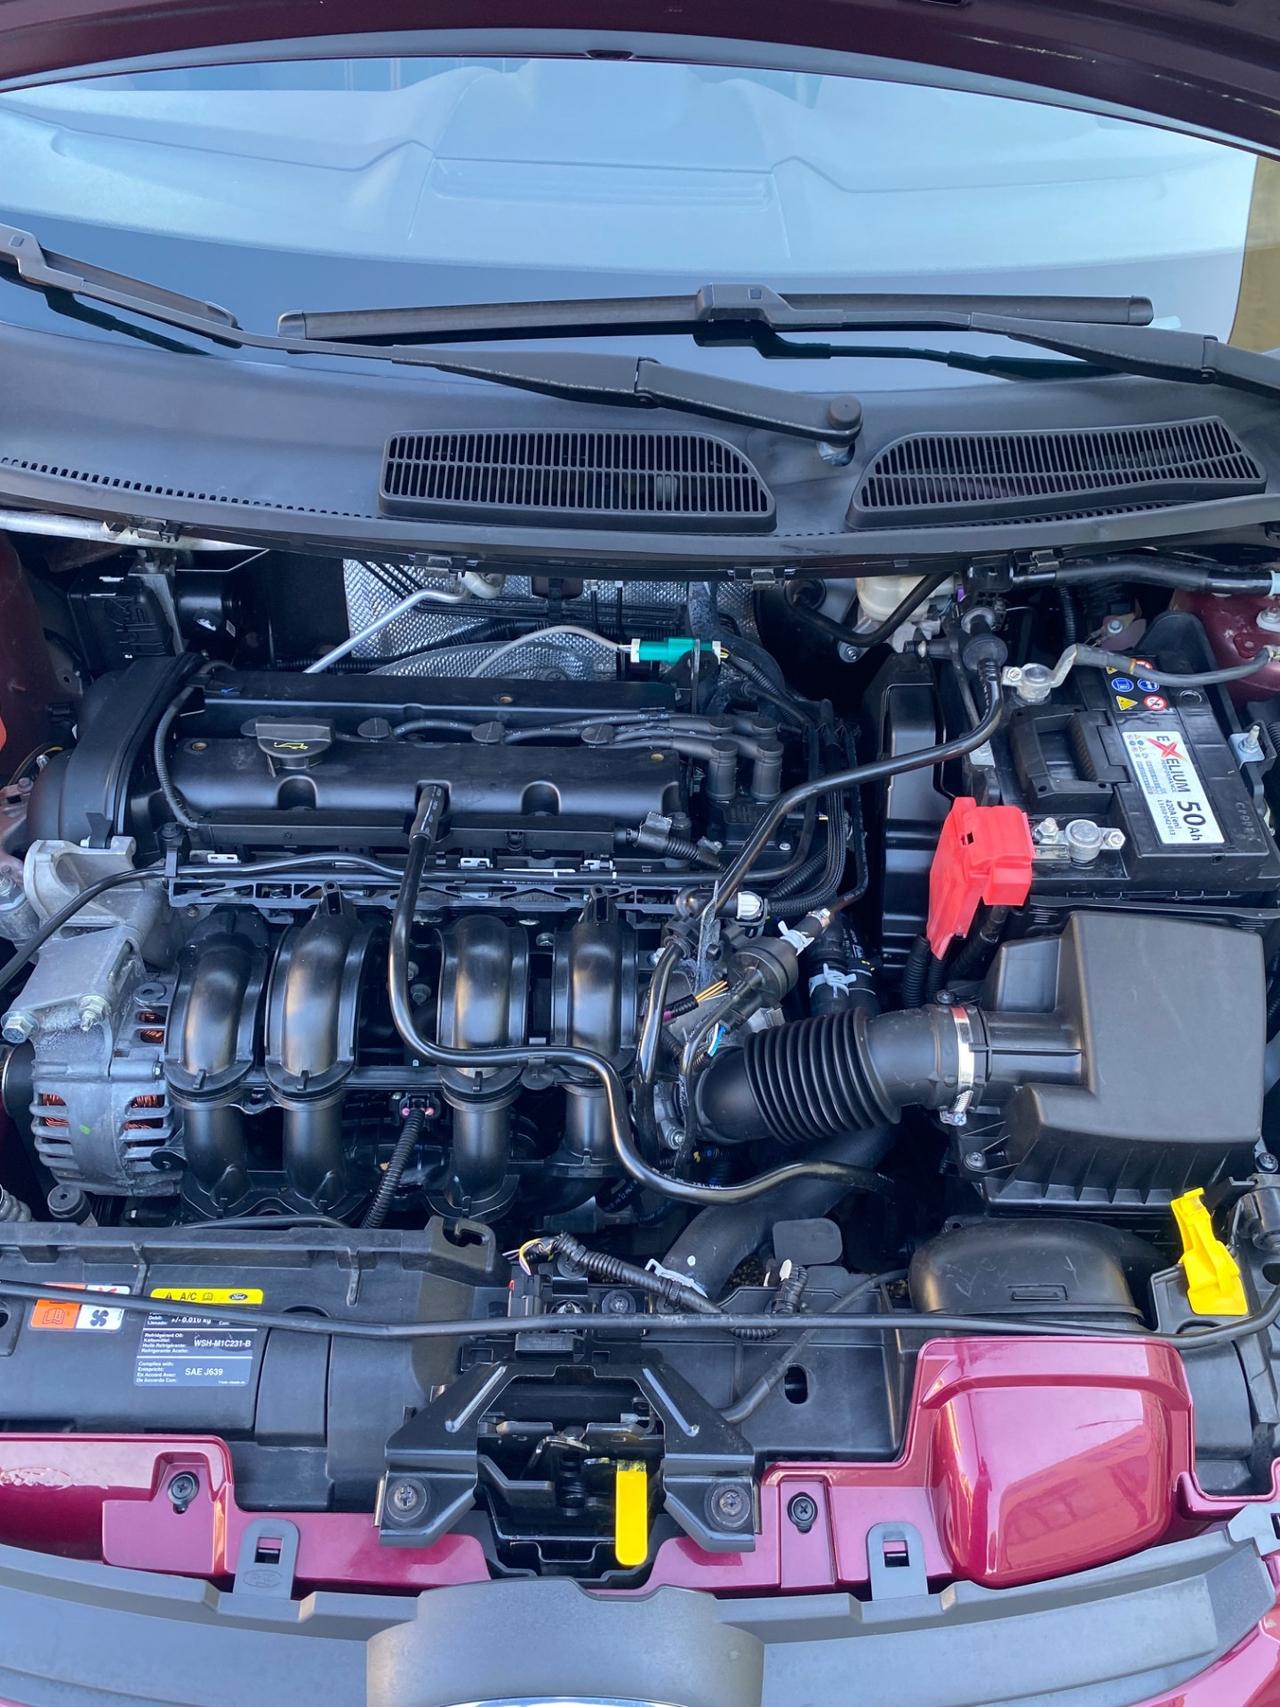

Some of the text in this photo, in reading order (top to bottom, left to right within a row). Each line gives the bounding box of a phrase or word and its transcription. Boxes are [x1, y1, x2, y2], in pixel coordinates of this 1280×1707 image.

[1148, 736, 1190, 793] EXELIUM
[180, 1292, 198, 1301] A/C
[230, 1293, 248, 1301] Ford
[194, 1339, 252, 1347] WSH-M1C231-B
[185, 1368, 224, 1376] SAE J639
